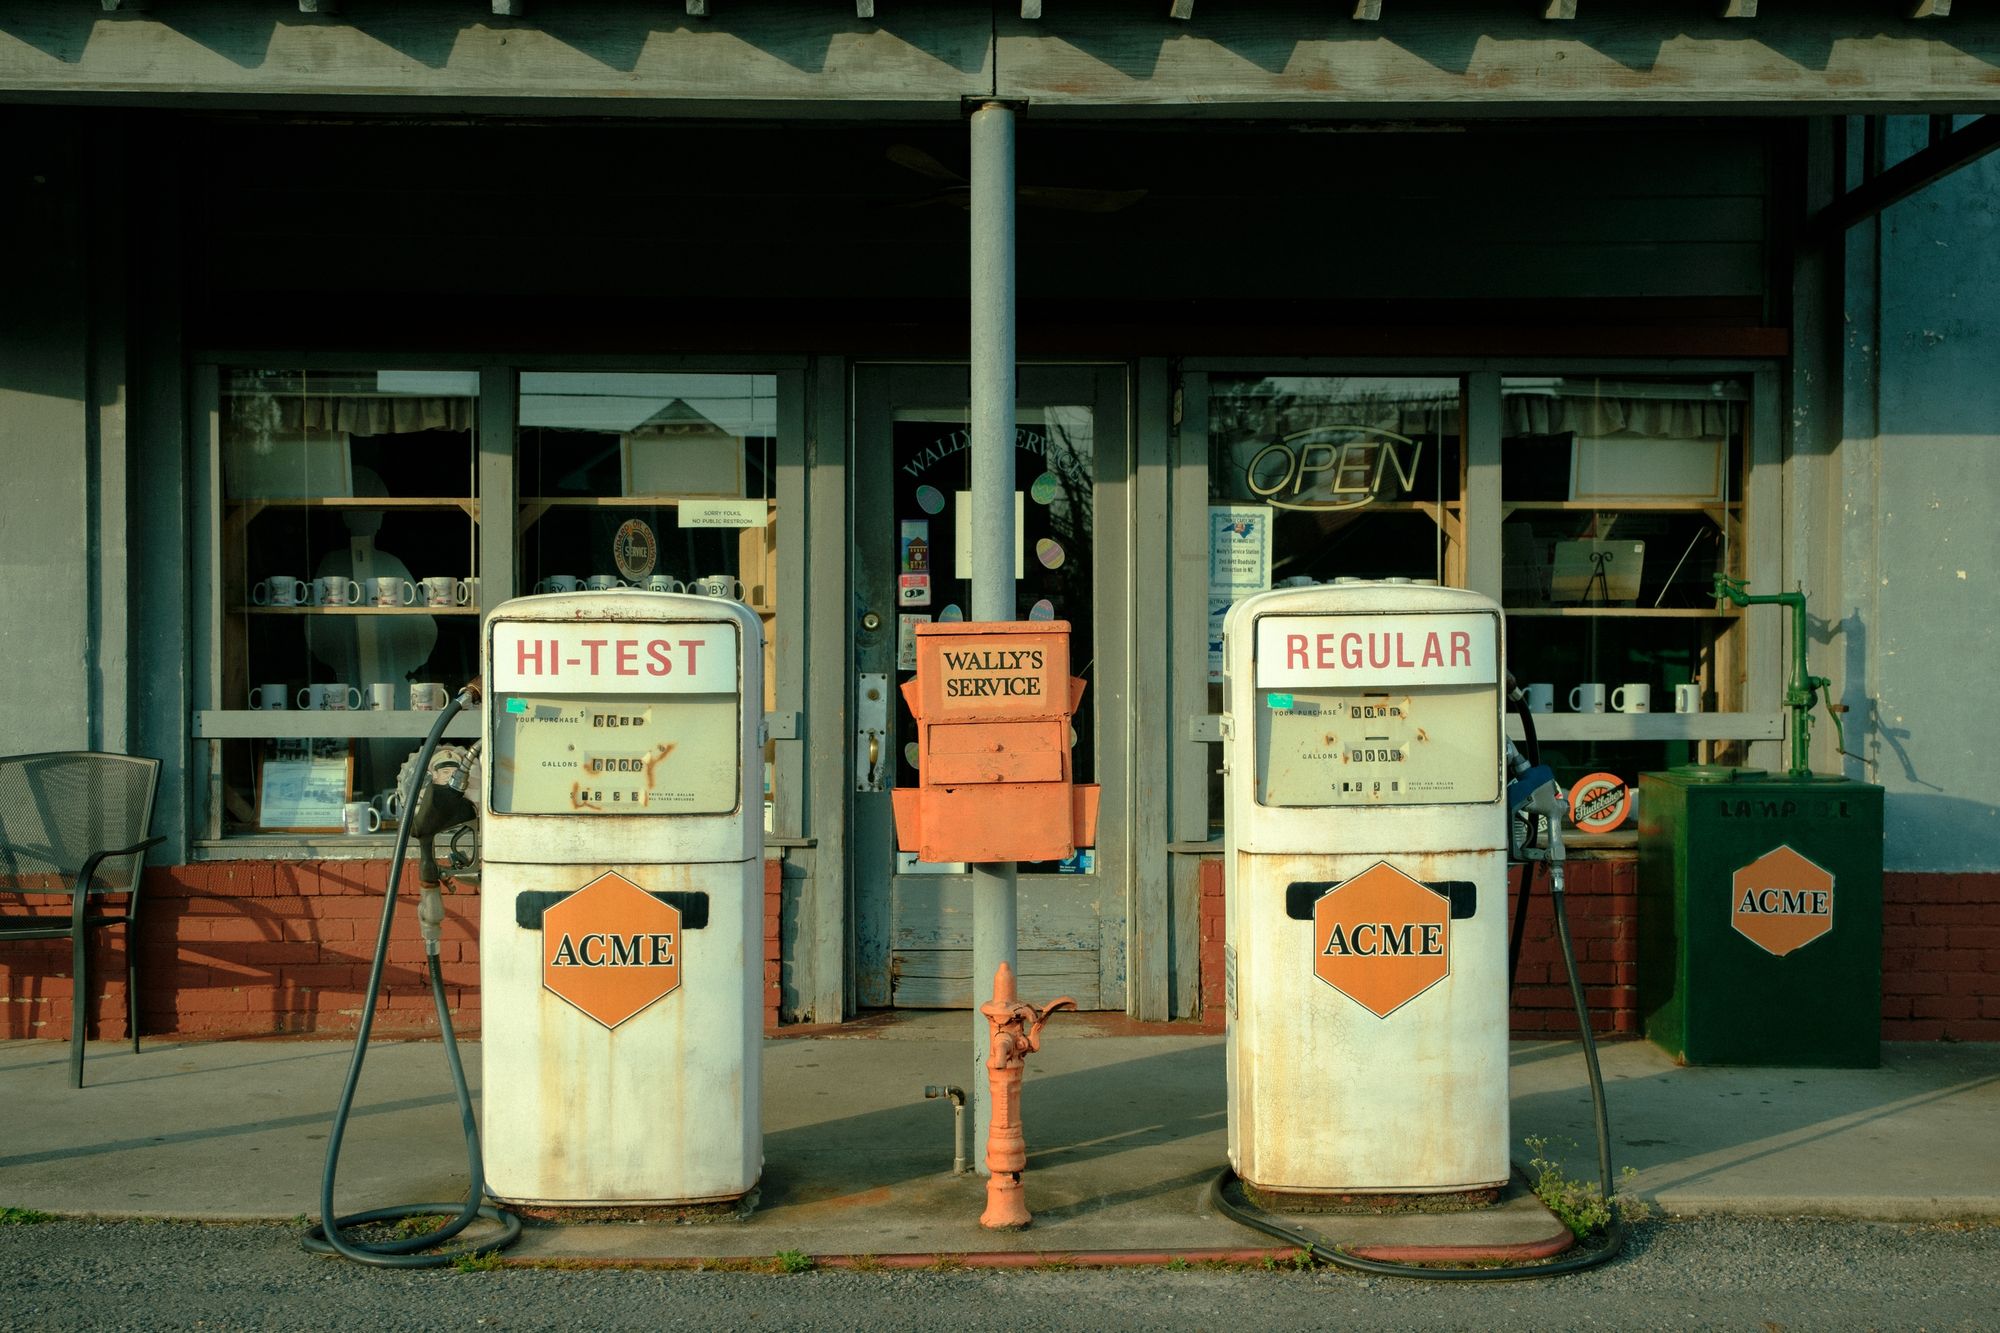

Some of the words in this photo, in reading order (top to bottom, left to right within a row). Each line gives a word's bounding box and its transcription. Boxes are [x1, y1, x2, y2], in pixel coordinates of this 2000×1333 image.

[1016, 429, 1085, 481] ERVICE
[1248, 441, 1423, 496] OPEN
[517, 639, 705, 677] HI-TEST
[943, 651, 1043, 671] WALLY'S
[1286, 631, 1473, 672] REGULAR
[946, 677, 1041, 697] SERVICE
[1297, 709, 1337, 717] PURCHASE
[1575, 788, 1624, 821] Studebaker
[1739, 888, 1829, 914] ACME
[551, 933, 674, 967] ACME
[1323, 923, 1443, 957] ACME
